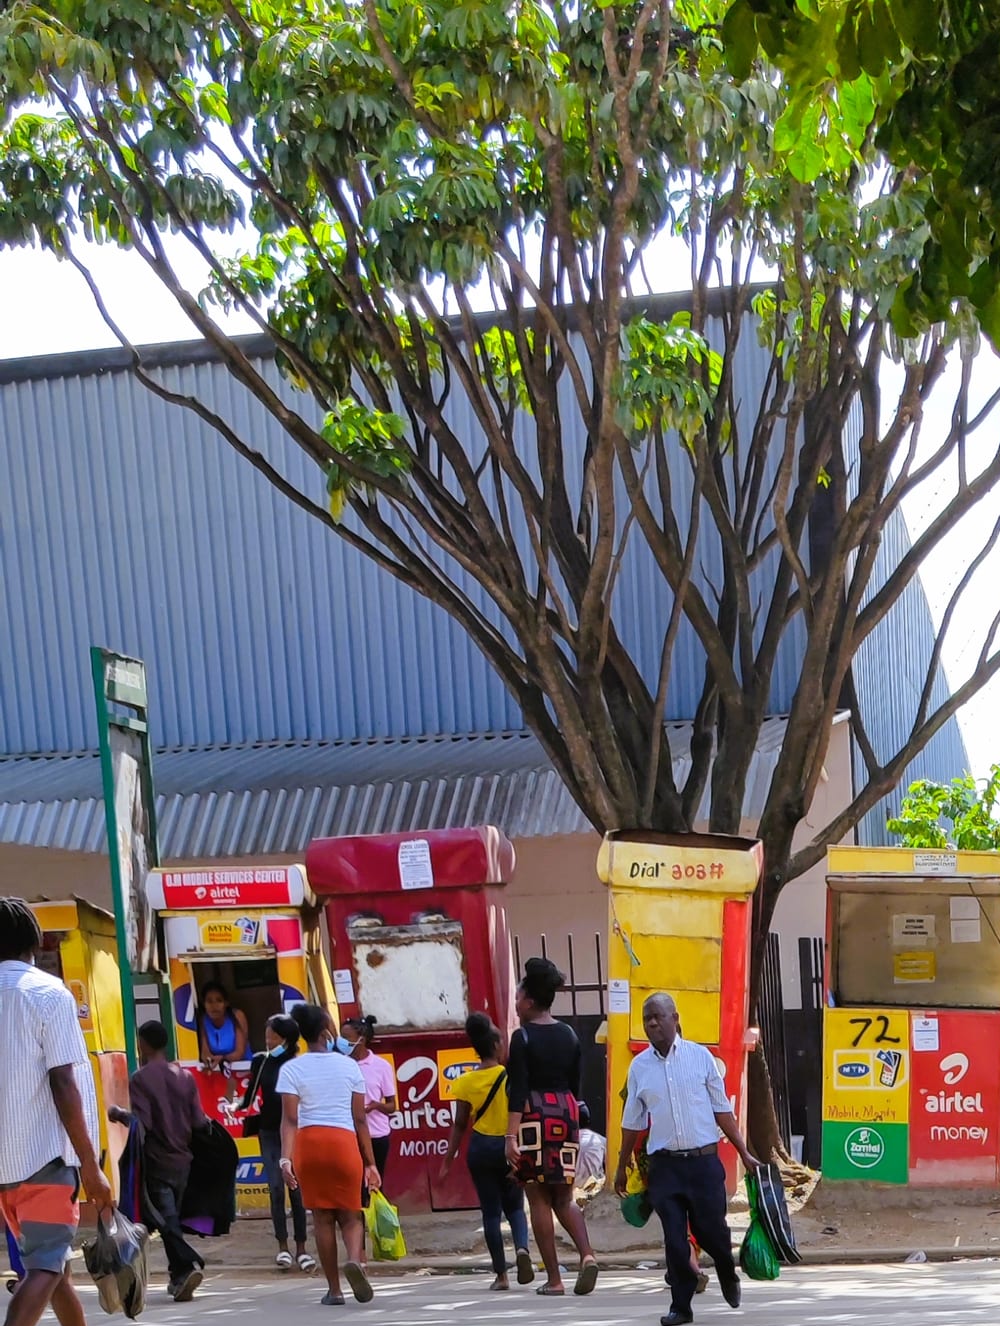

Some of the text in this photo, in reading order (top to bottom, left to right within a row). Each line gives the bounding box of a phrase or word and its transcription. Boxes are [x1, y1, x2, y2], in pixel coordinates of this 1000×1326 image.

[182, 872, 214, 886] MOBILE
[214, 870, 254, 885] SERVICES
[254, 869, 286, 883] CENTER
[671, 862, 724, 880] 303#
[210, 886, 240, 898] airtel
[849, 1015, 901, 1047] 72
[842, 1065, 867, 1074] MTN
[925, 1090, 984, 1113] airtel
[930, 1126, 989, 1144] money
